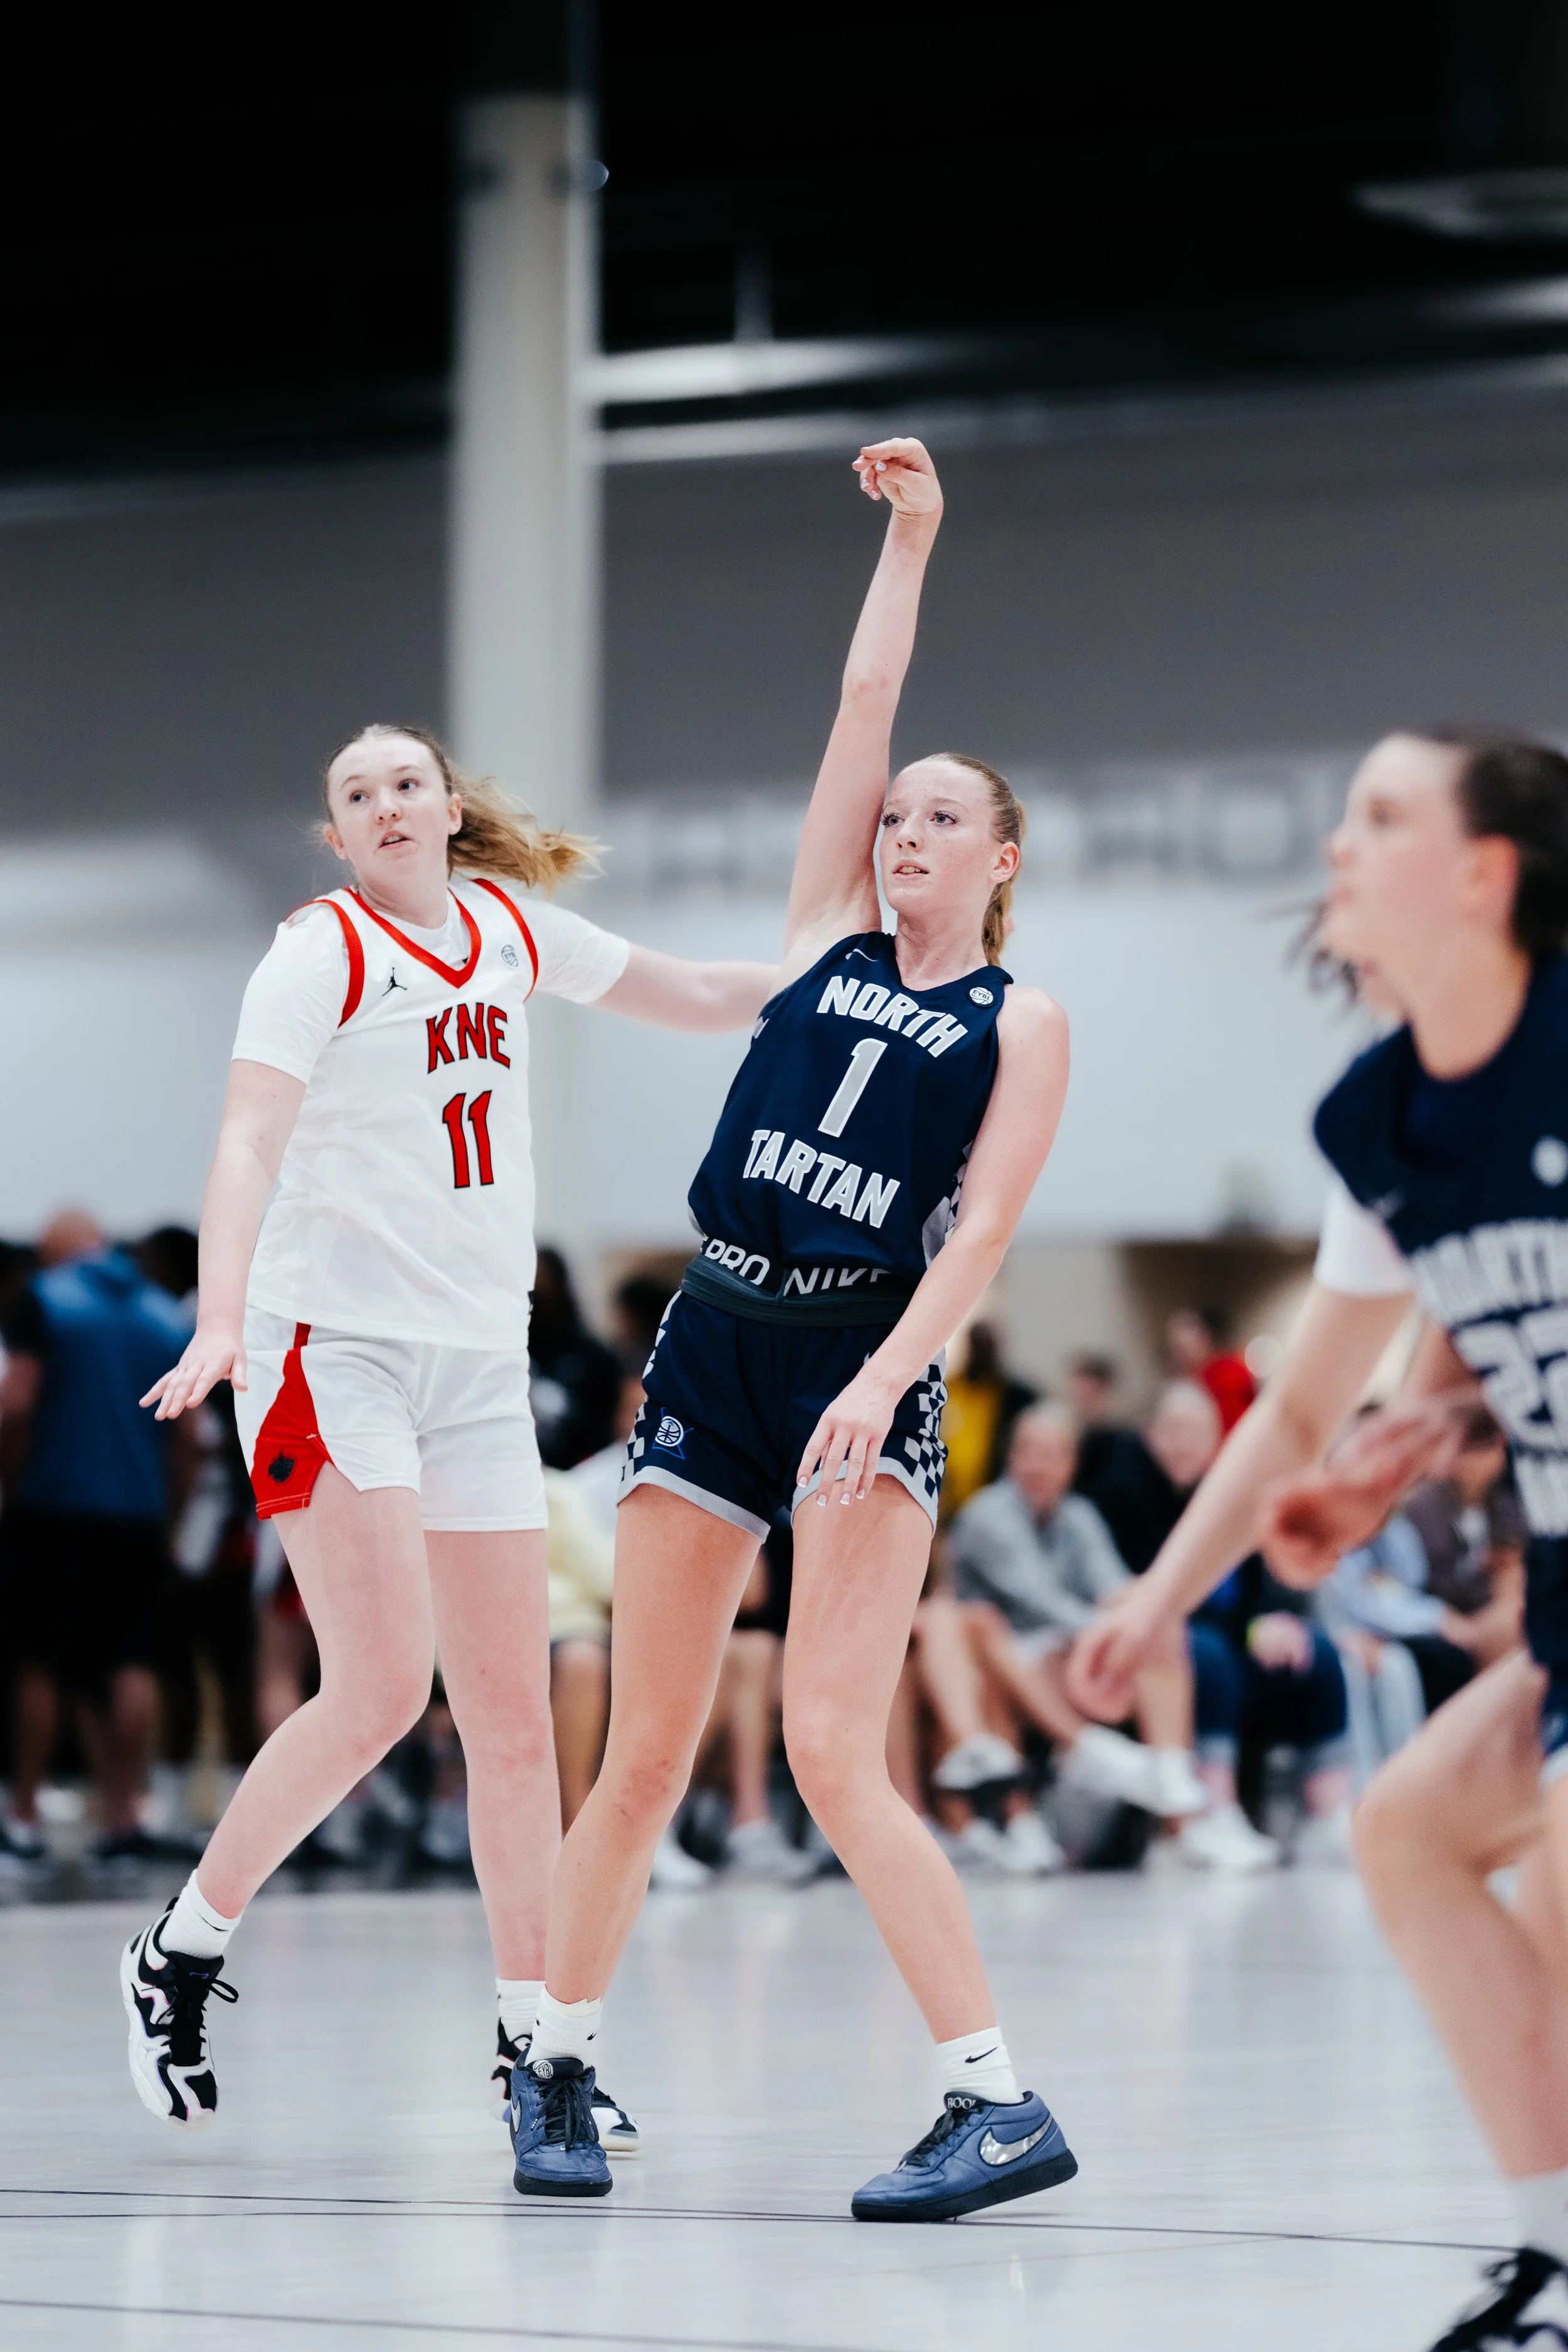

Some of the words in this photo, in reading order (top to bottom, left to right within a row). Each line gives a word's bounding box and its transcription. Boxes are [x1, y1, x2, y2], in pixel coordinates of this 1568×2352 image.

[426, 1002, 511, 1074] KNE
[815, 975, 968, 1058] NORTH
[972, 989, 990, 1001] EYBL
[817, 1037, 888, 1138] 1
[442, 1089, 494, 1189] 11
[743, 1129, 901, 1229] TARTAN
